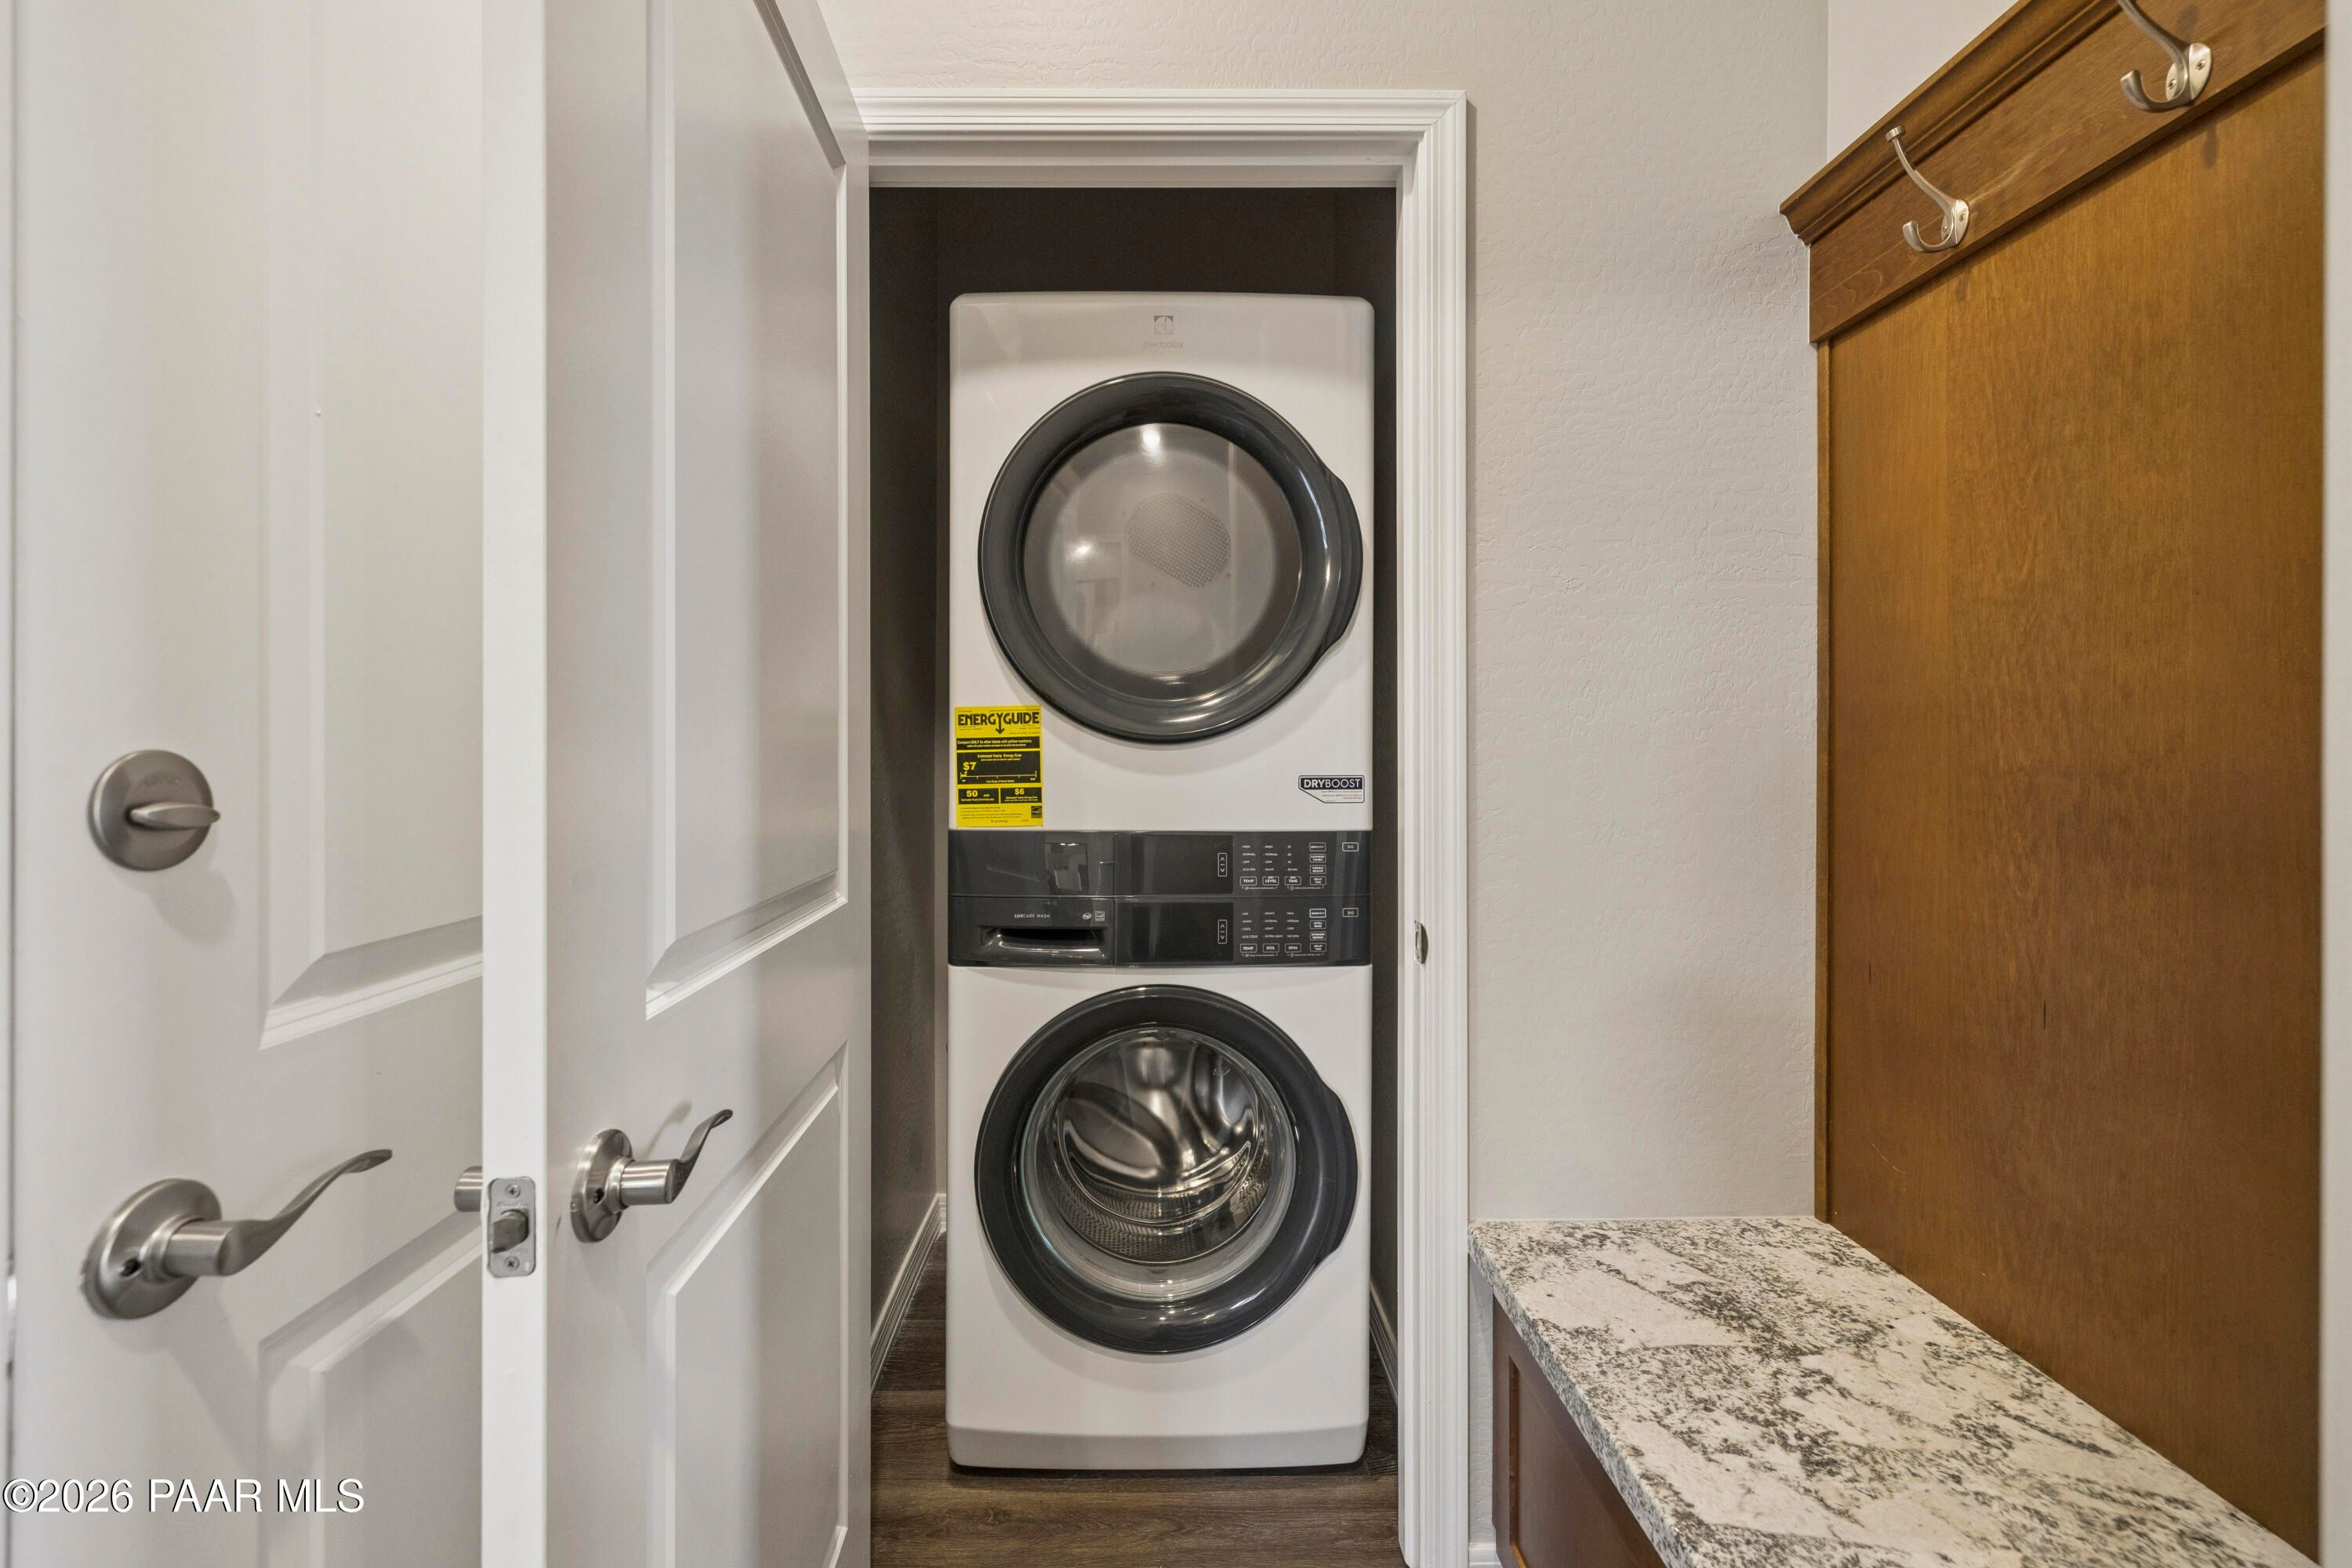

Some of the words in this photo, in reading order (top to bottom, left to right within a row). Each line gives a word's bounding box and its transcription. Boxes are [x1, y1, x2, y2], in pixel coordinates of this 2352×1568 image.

[958, 712, 1040, 726] ENERGYGUIDE
[963, 761, 977, 771] $7
[1304, 779, 1360, 788] DRYBOOST
